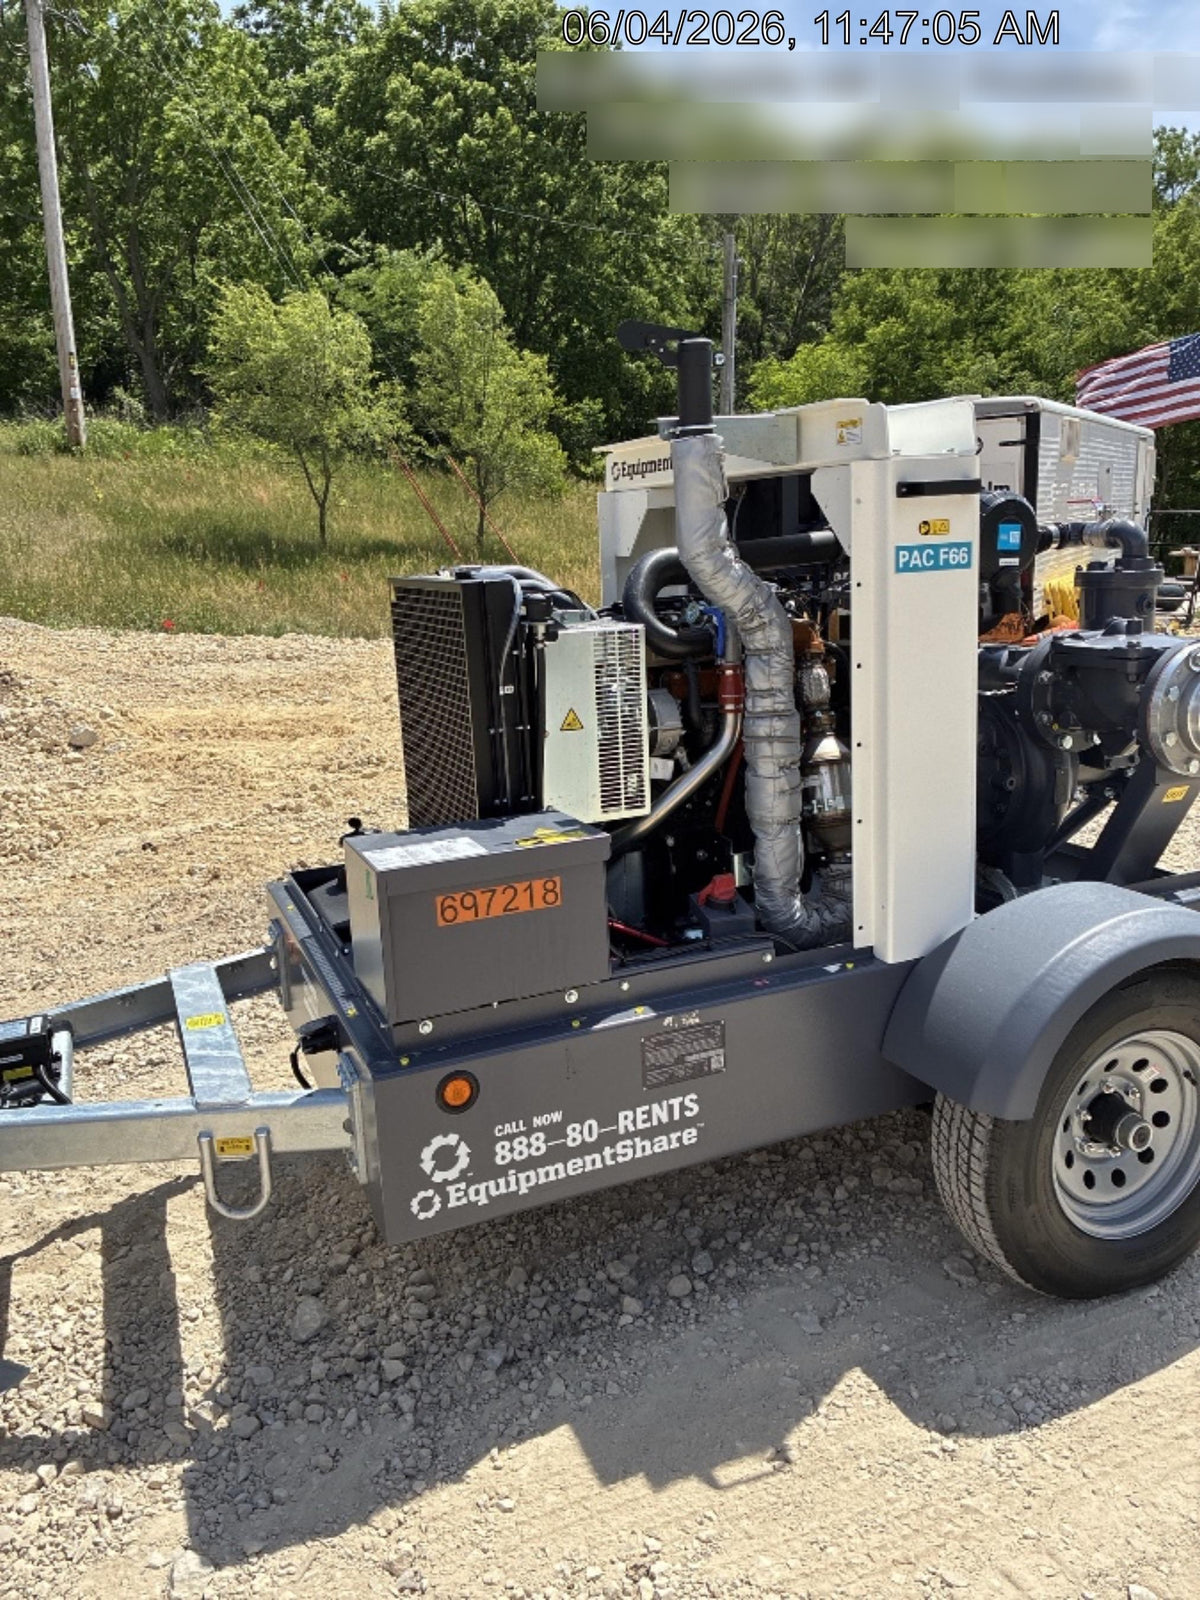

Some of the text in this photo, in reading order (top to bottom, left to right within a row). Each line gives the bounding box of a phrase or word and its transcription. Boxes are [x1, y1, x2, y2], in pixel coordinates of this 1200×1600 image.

[899, 547, 969, 568] PAC F66
[440, 879, 559, 923] 697218
[494, 1110, 563, 1137] CALL NOW
